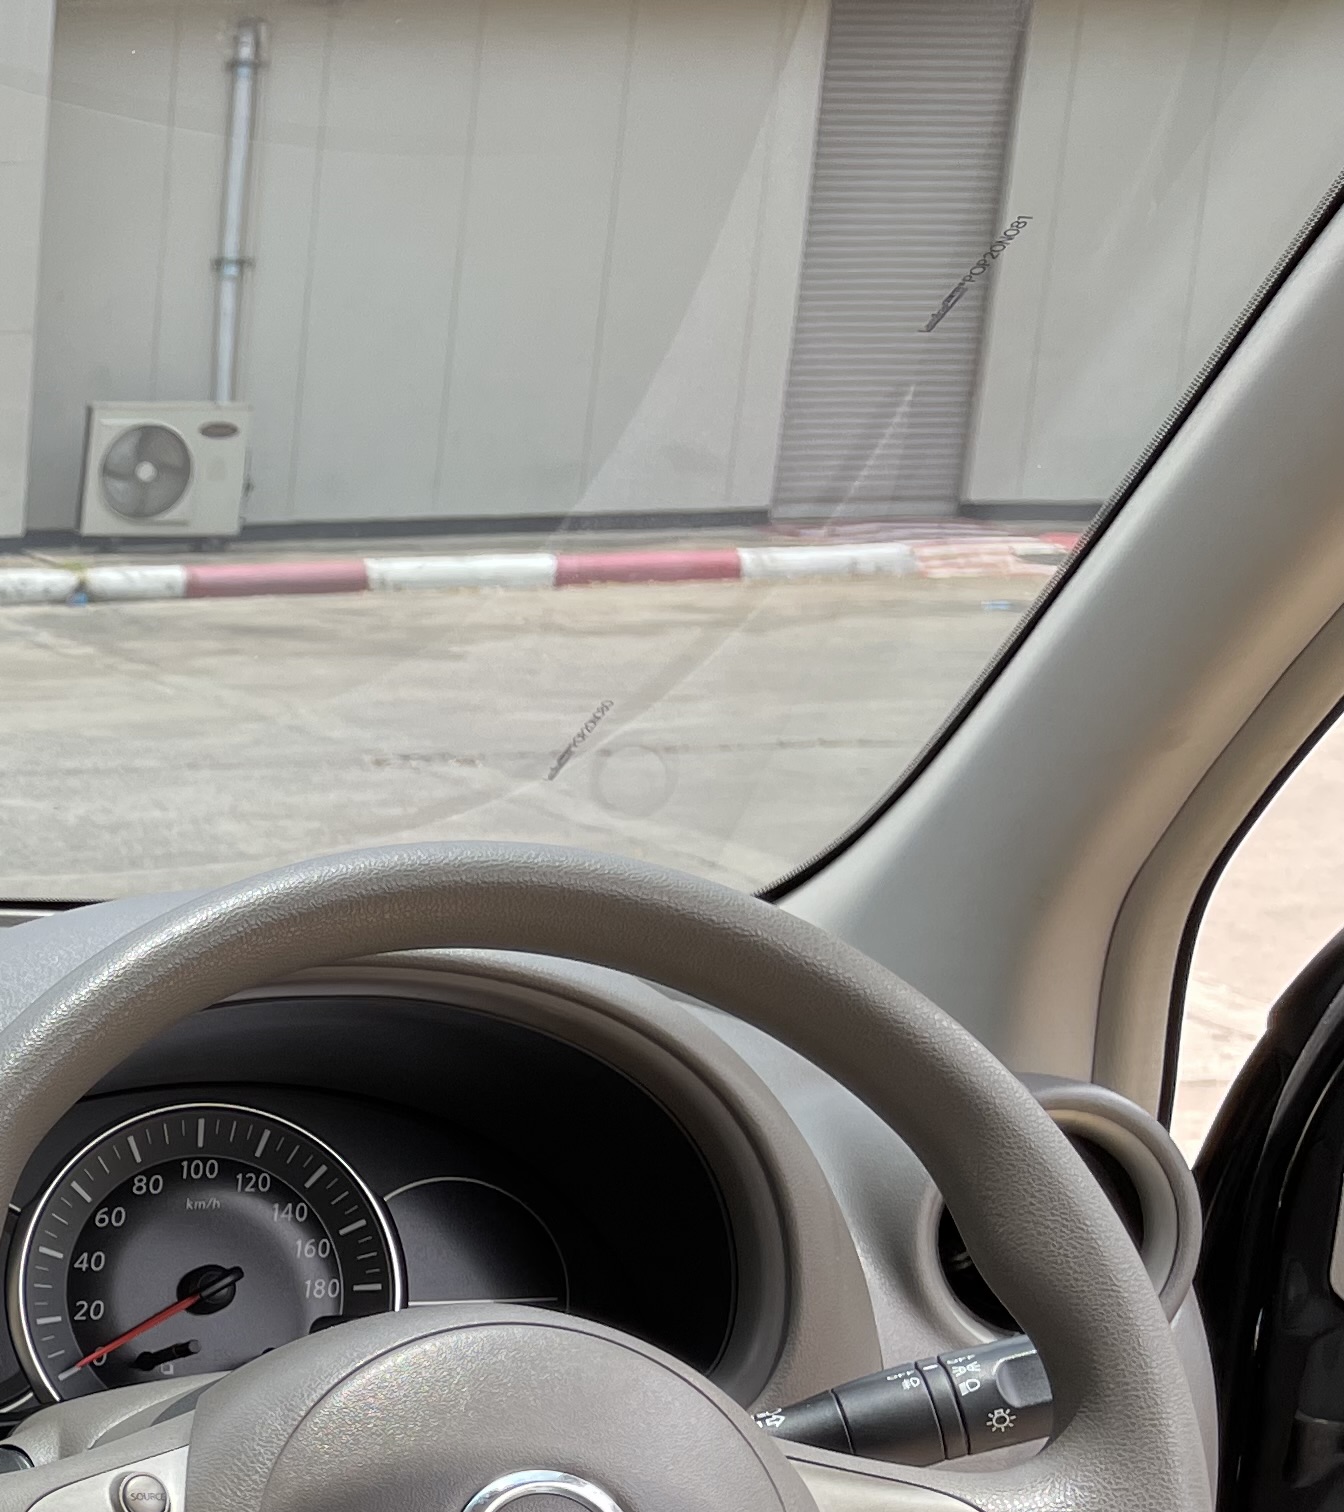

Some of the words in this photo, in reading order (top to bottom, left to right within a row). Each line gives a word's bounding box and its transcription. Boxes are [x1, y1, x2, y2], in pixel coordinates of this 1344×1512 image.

[180, 1159, 220, 1180] 100
[132, 1174, 164, 1195] 80
[235, 1172, 272, 1194] 120
[186, 1197, 222, 1211] km/h
[272, 1202, 309, 1224] 140
[94, 1206, 127, 1228] 60
[295, 1238, 331, 1260] 160
[73, 1251, 106, 1273] 40
[304, 1278, 341, 1300] 180
[73, 1299, 105, 1321] 20
